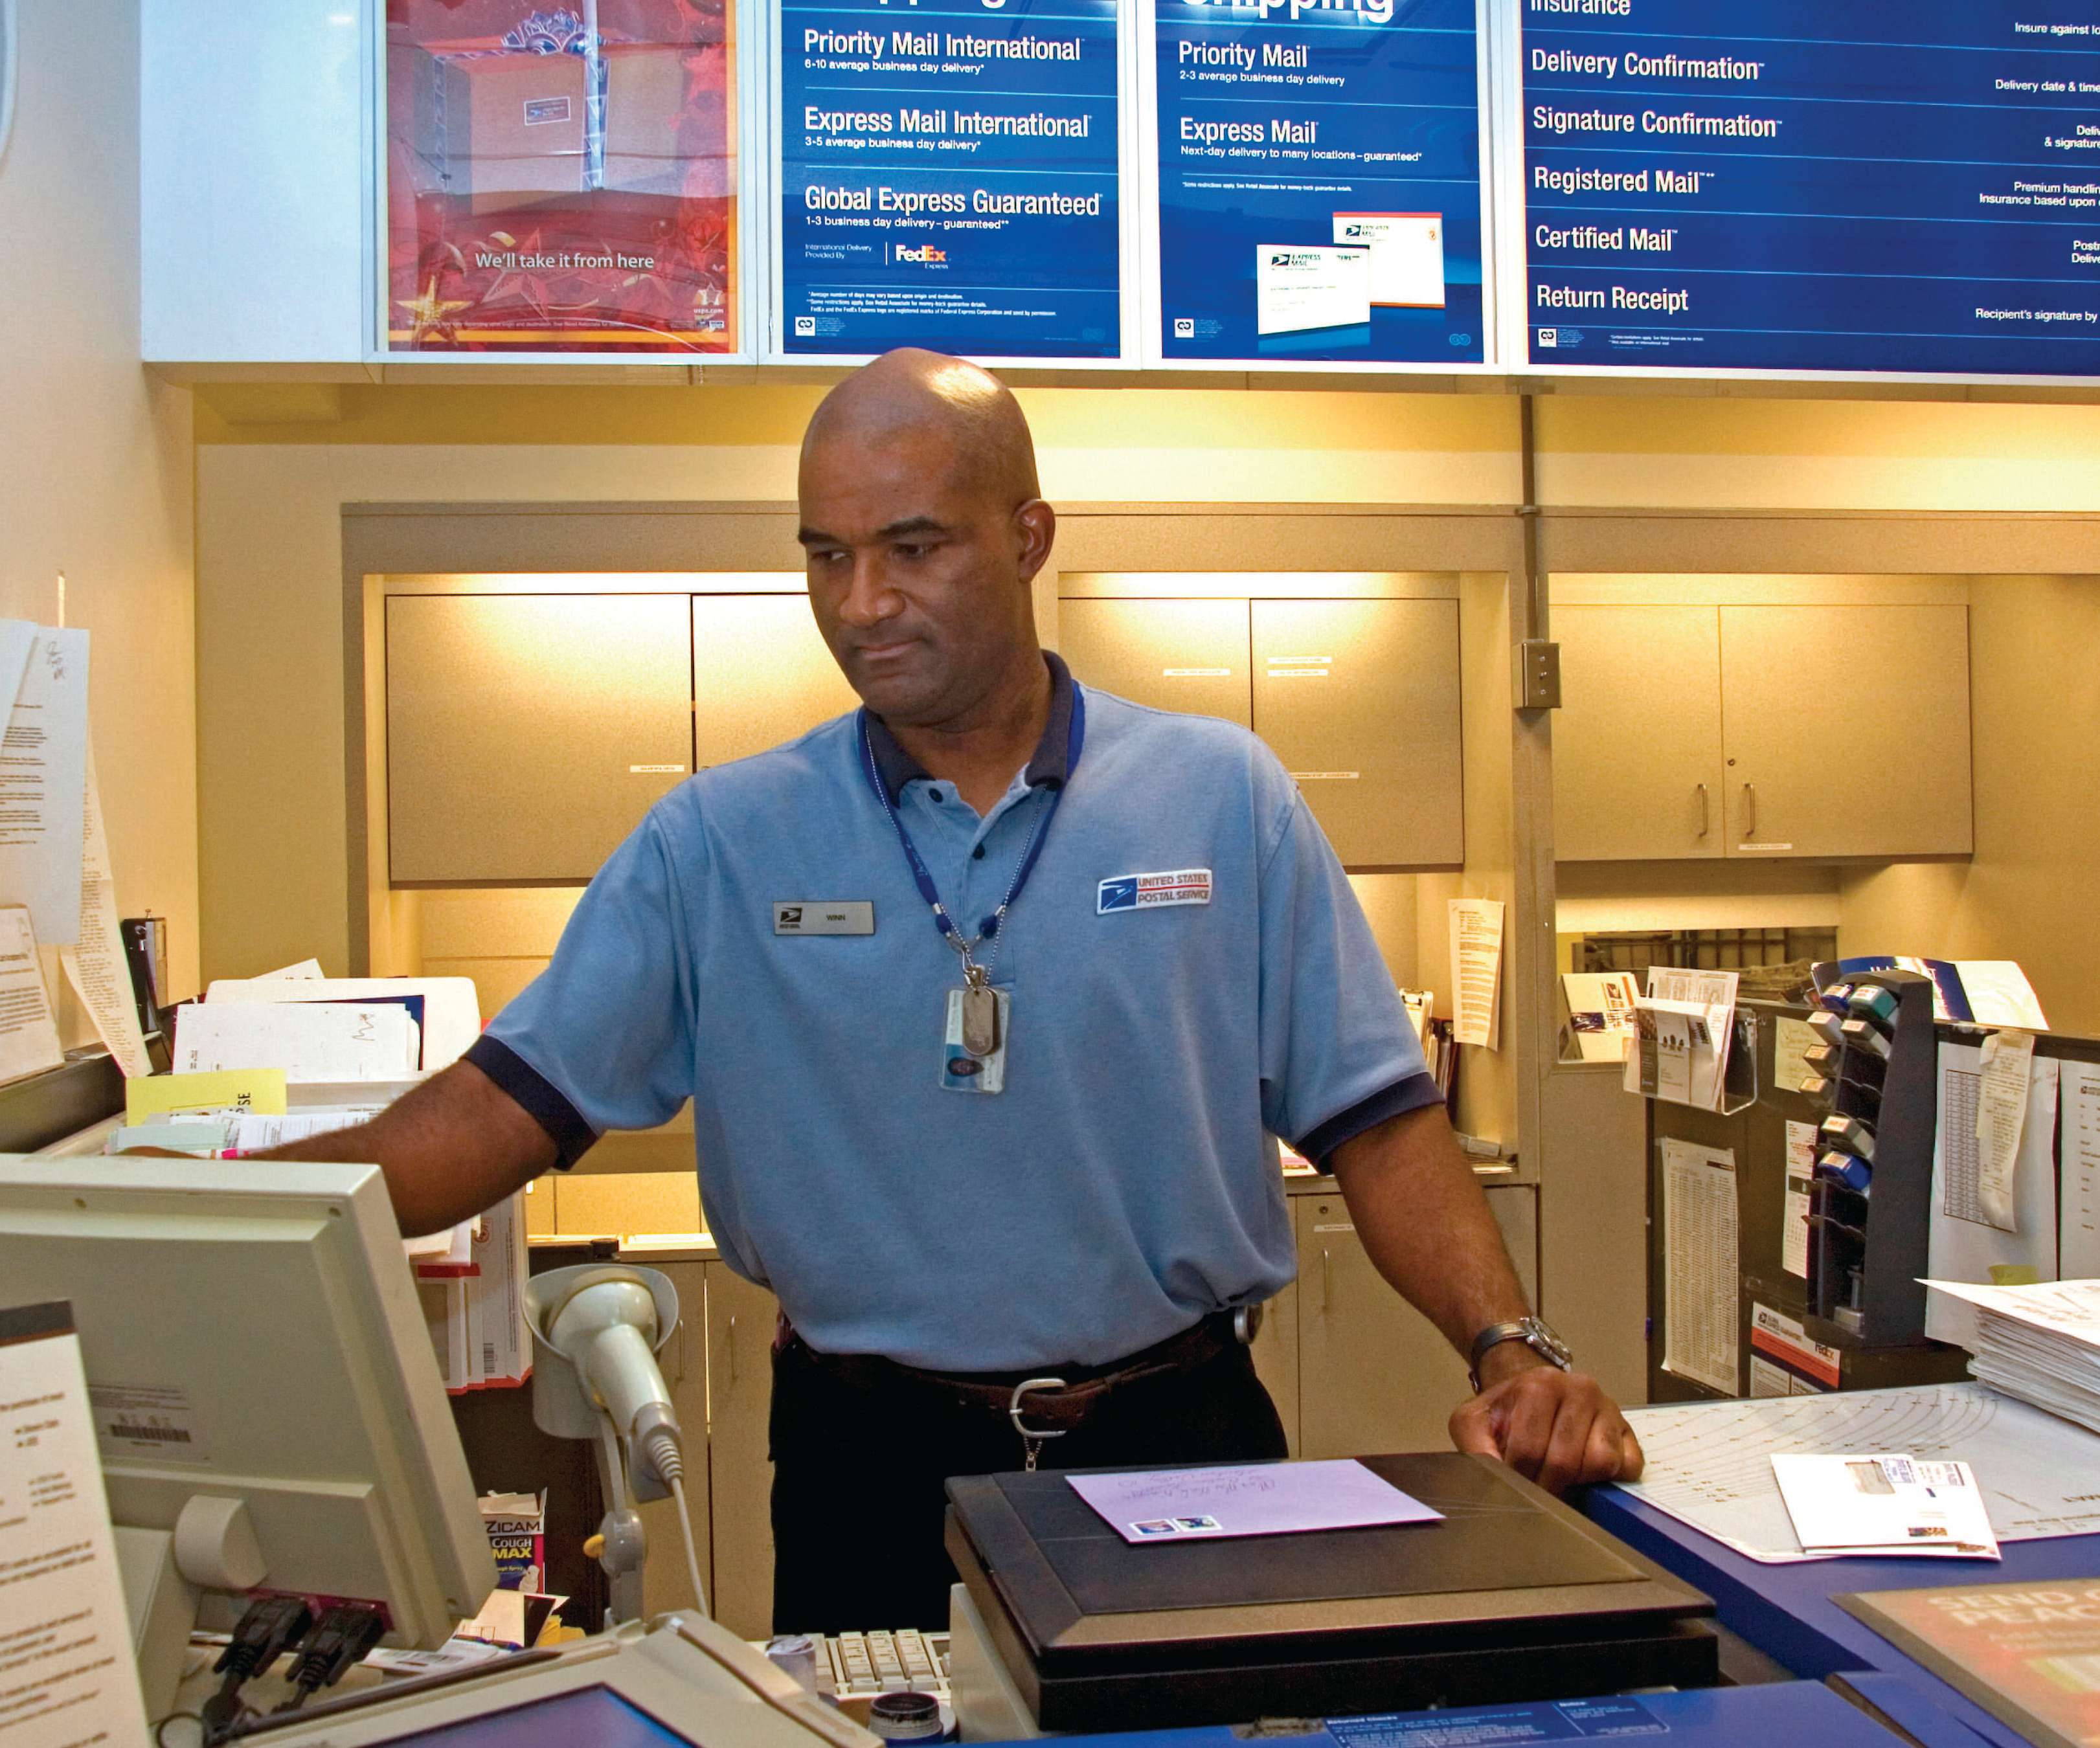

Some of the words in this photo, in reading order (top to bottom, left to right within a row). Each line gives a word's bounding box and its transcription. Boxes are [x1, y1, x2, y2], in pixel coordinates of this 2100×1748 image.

[2015, 22, 2048, 32] Insure
[2051, 25, 2089, 36] against
[805, 29, 885, 60] Priority
[893, 31, 938, 56] Mail
[1179, 40, 1256, 71] Priority
[1263, 44, 1307, 67] Mail
[805, 59, 826, 68] 6-10
[830, 62, 870, 72] average
[872, 61, 917, 71] business
[920, 62, 938, 73] day
[1533, 49, 1617, 78] Delivery
[1180, 70, 1195, 80] 2-3
[1199, 73, 1237, 83] average
[1241, 73, 1283, 82] business
[1286, 74, 1304, 85] day
[1307, 75, 1344, 87] delivery
[1996, 79, 2038, 93] Delivery
[2042, 82, 2065, 91] date
[2068, 82, 2075, 91] &
[806, 106, 892, 135] Express
[900, 109, 945, 133] Mail
[1534, 106, 1634, 133] Signature
[1181, 117, 1264, 145] Express
[1272, 120, 1315, 143] Mail
[806, 137, 822, 146] 3-5
[826, 139, 866, 149] average
[869, 138, 914, 148] business
[917, 139, 935, 151] day
[2045, 137, 2052, 146] &
[1181, 146, 1225, 158] Next-day
[1228, 147, 1267, 159] delivery
[1270, 149, 1280, 157] to
[1282, 150, 1309, 160] many
[1312, 150, 1355, 159] locations
[1535, 166, 1647, 194] Registered
[2015, 182, 2060, 192] Premium
[806, 185, 870, 210] Global
[879, 186, 965, 216] Express
[1980, 194, 2031, 204] Insurance
[2034, 196, 2066, 205] based
[2069, 199, 2095, 207] upon
[806, 216, 821, 225] 1-3
[825, 216, 870, 226] business
[873, 218, 892, 229] day
[895, 218, 934, 229] delivery
[1536, 225, 1622, 249] Certified
[519, 253, 555, 268] take
[559, 253, 570, 268] it
[574, 253, 613, 268] from
[617, 253, 655, 269] here
[896, 245, 946, 262] FedEx
[1537, 285, 1605, 308] Return
[1612, 286, 1688, 315] Receipt
[2035, 311, 2082, 322] signature
[2085, 311, 2097, 323] by
[1138, 877, 1174, 887] UNITED
[1177, 874, 1208, 883] STATES
[1138, 892, 1175, 903] POSTAL
[1177, 890, 1209, 900] SERVICE
[486, 1521, 540, 1534] ZICAM
[492, 1547, 532, 1560] MAX
[1927, 1592, 2075, 1610] SEND
